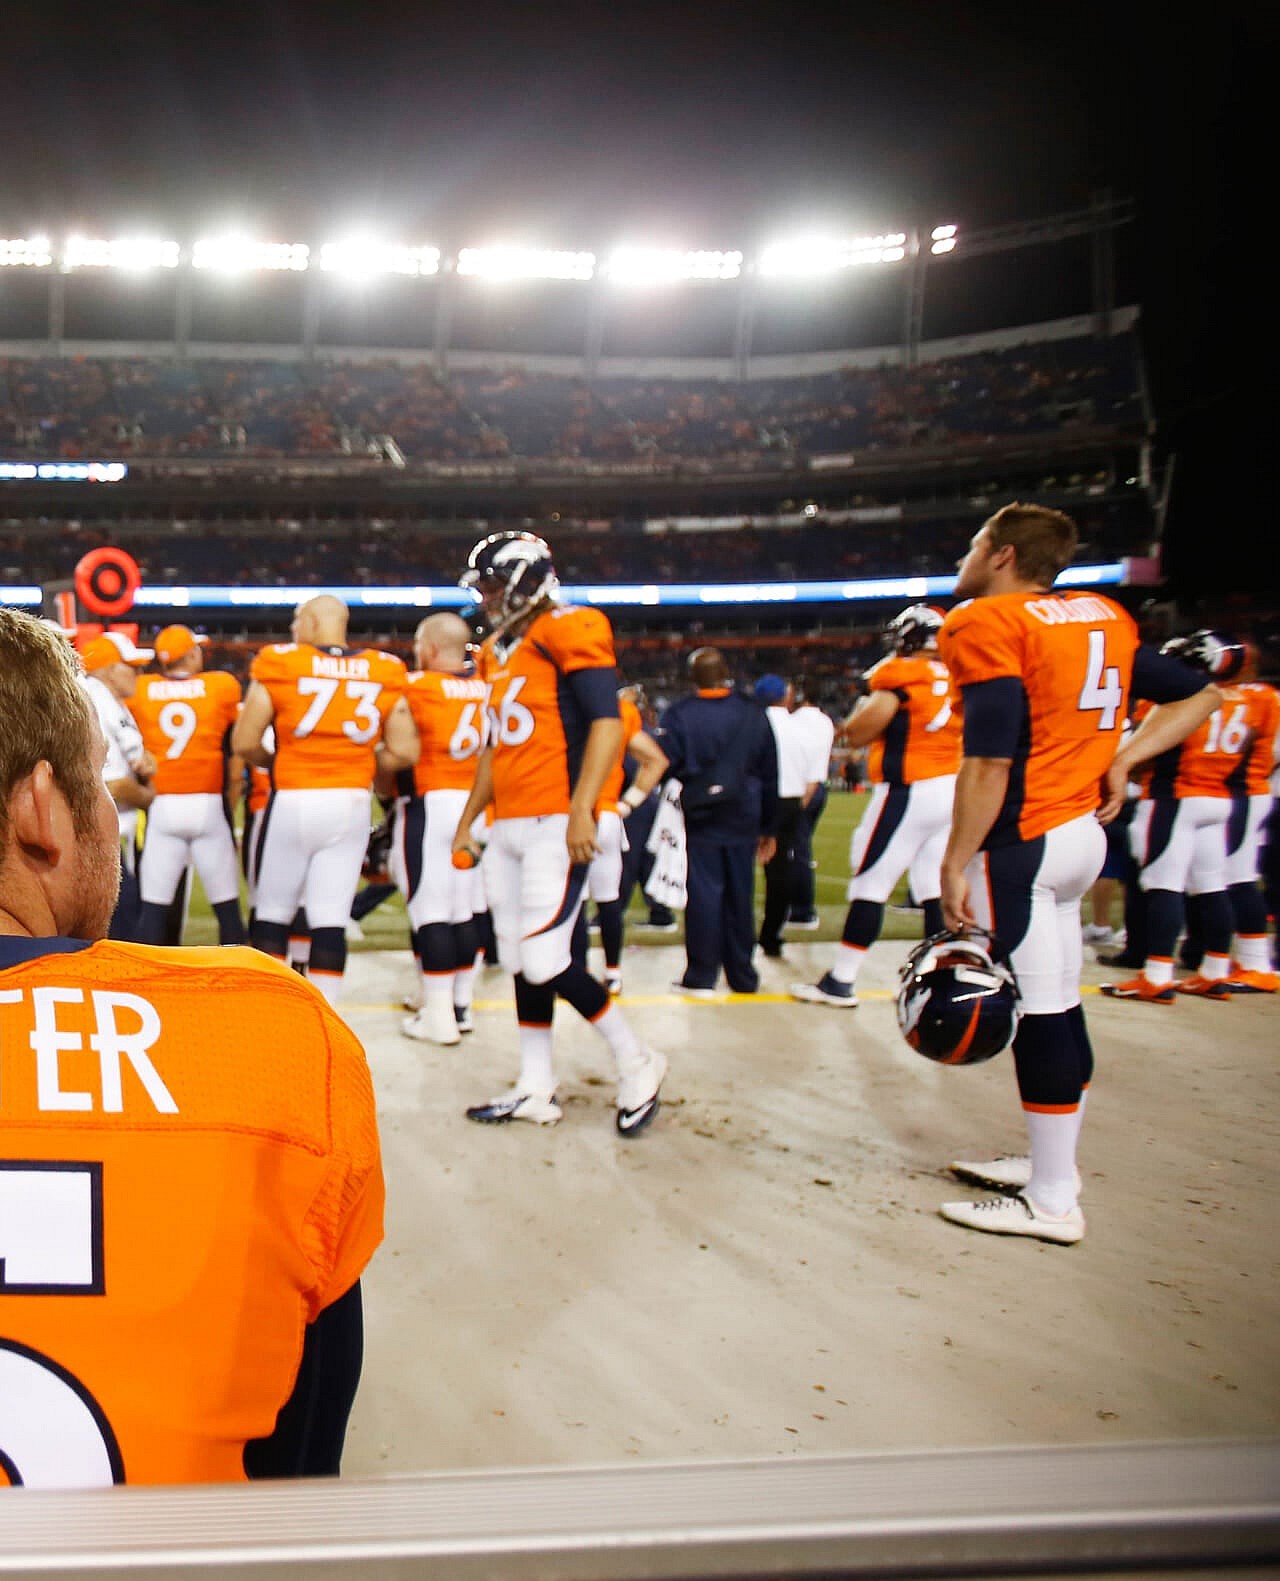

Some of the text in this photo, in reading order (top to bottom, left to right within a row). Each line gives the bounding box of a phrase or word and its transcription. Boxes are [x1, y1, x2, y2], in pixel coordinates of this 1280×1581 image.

[312, 656, 370, 679] MILLER
[1078, 629, 1122, 729] 4
[159, 701, 197, 759] 9
[294, 677, 383, 744] 73
[1203, 704, 1248, 754] 16
